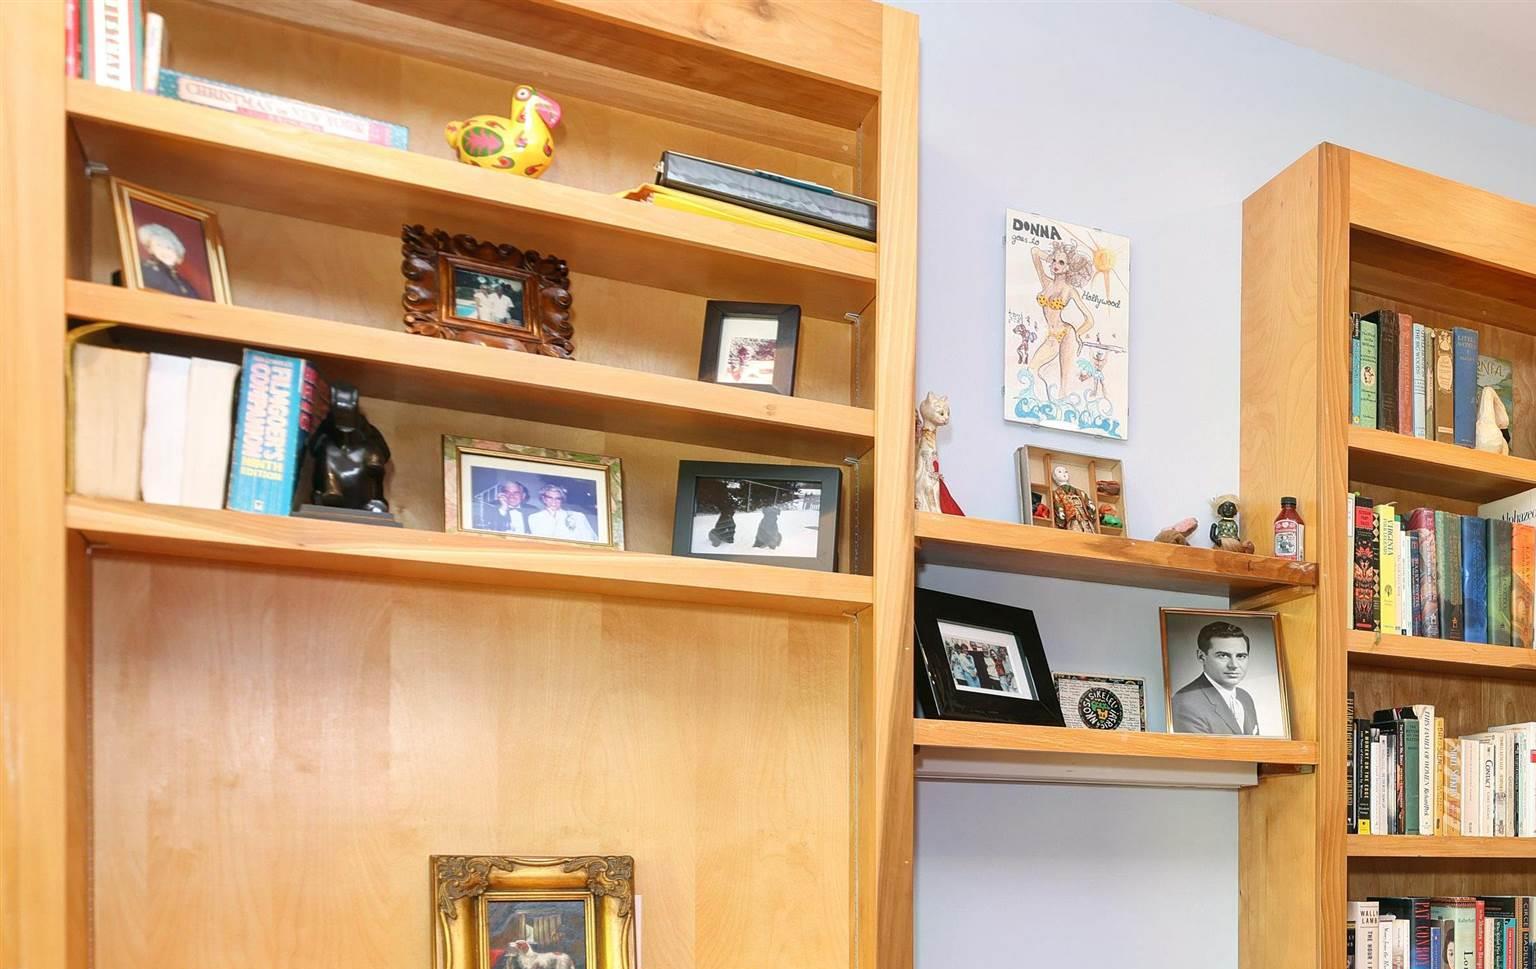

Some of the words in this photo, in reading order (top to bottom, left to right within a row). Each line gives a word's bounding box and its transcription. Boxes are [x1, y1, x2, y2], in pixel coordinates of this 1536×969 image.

[1012, 218, 1062, 241] DONNA
[1082, 290, 1121, 313] Hollywood
[1424, 751, 1430, 759] OF
[1485, 760, 1493, 789] CONTACT
[1415, 902, 1430, 919] PAT
[1415, 926, 1430, 967] CONROY
